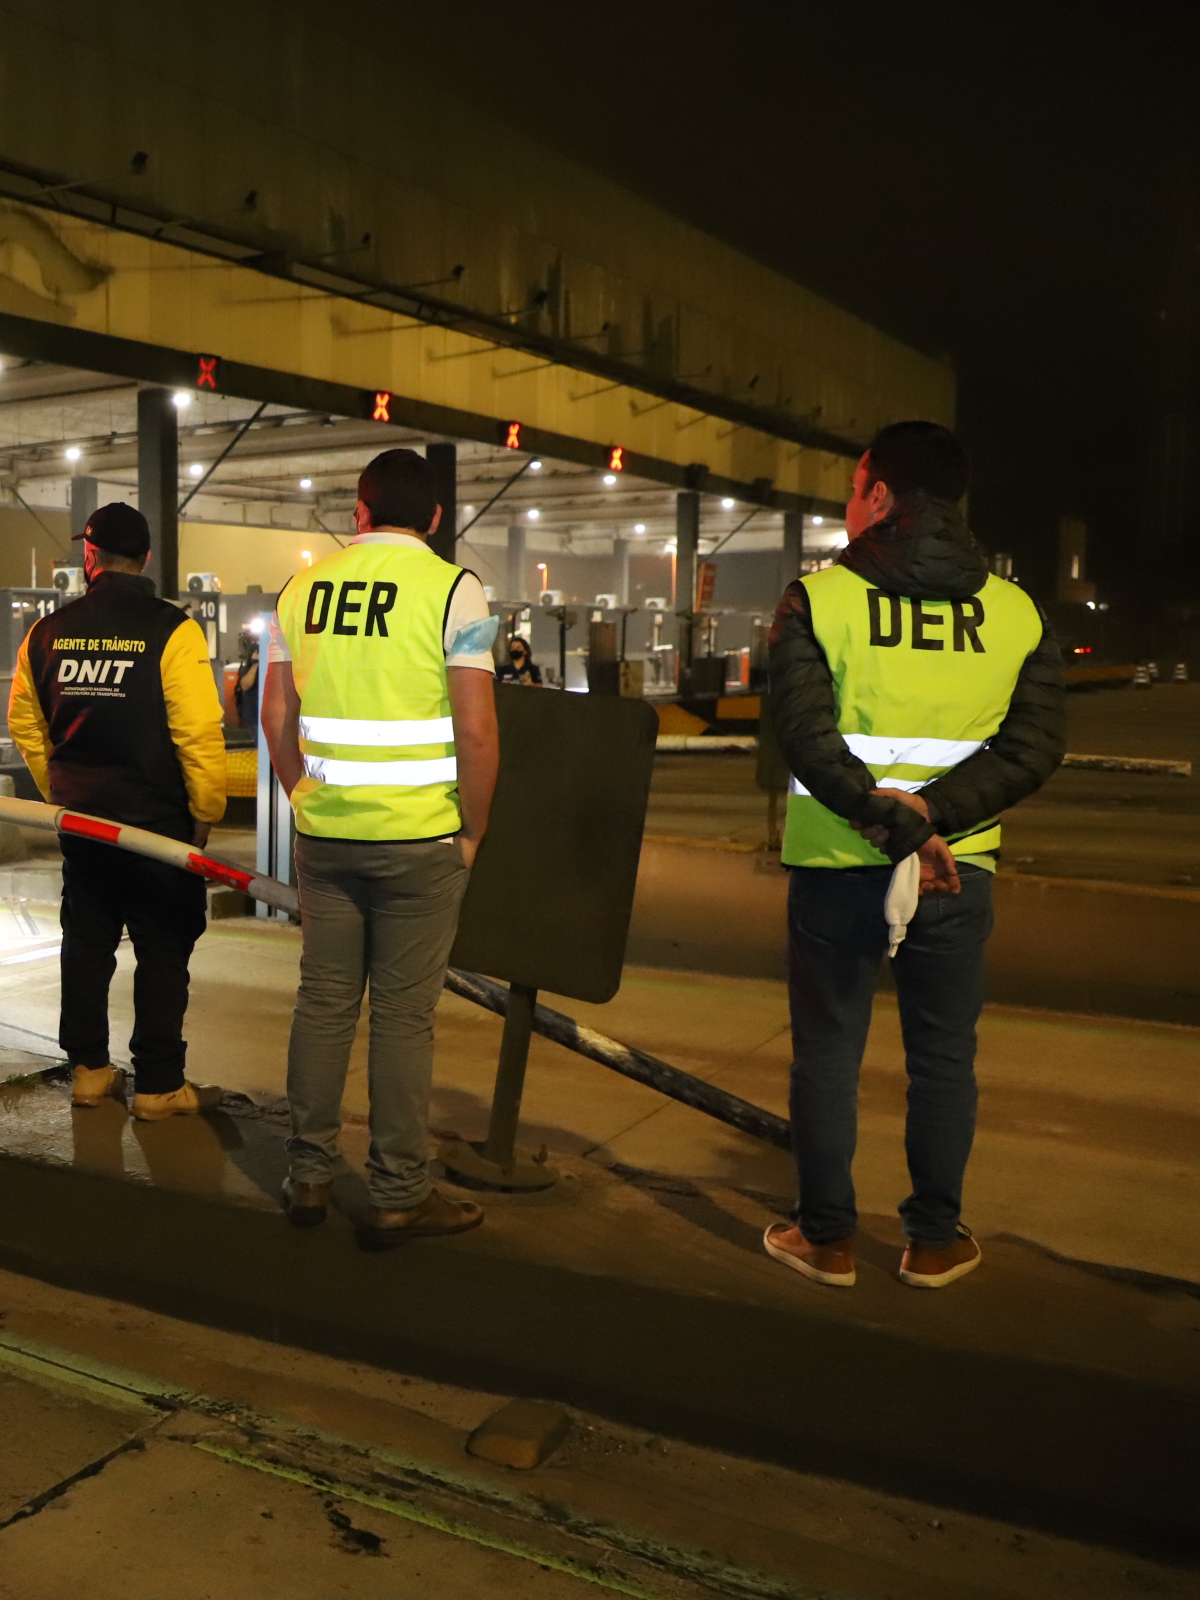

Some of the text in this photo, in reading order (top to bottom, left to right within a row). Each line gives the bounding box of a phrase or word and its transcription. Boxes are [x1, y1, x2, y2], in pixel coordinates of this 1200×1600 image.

[37, 600, 55, 618] 11
[201, 601, 216, 618] 10
[305, 581, 398, 637] DER
[866, 588, 986, 653] DER
[52, 636, 146, 653] AGENTE DE TRÂNSITO
[57, 659, 135, 684] DNIT
